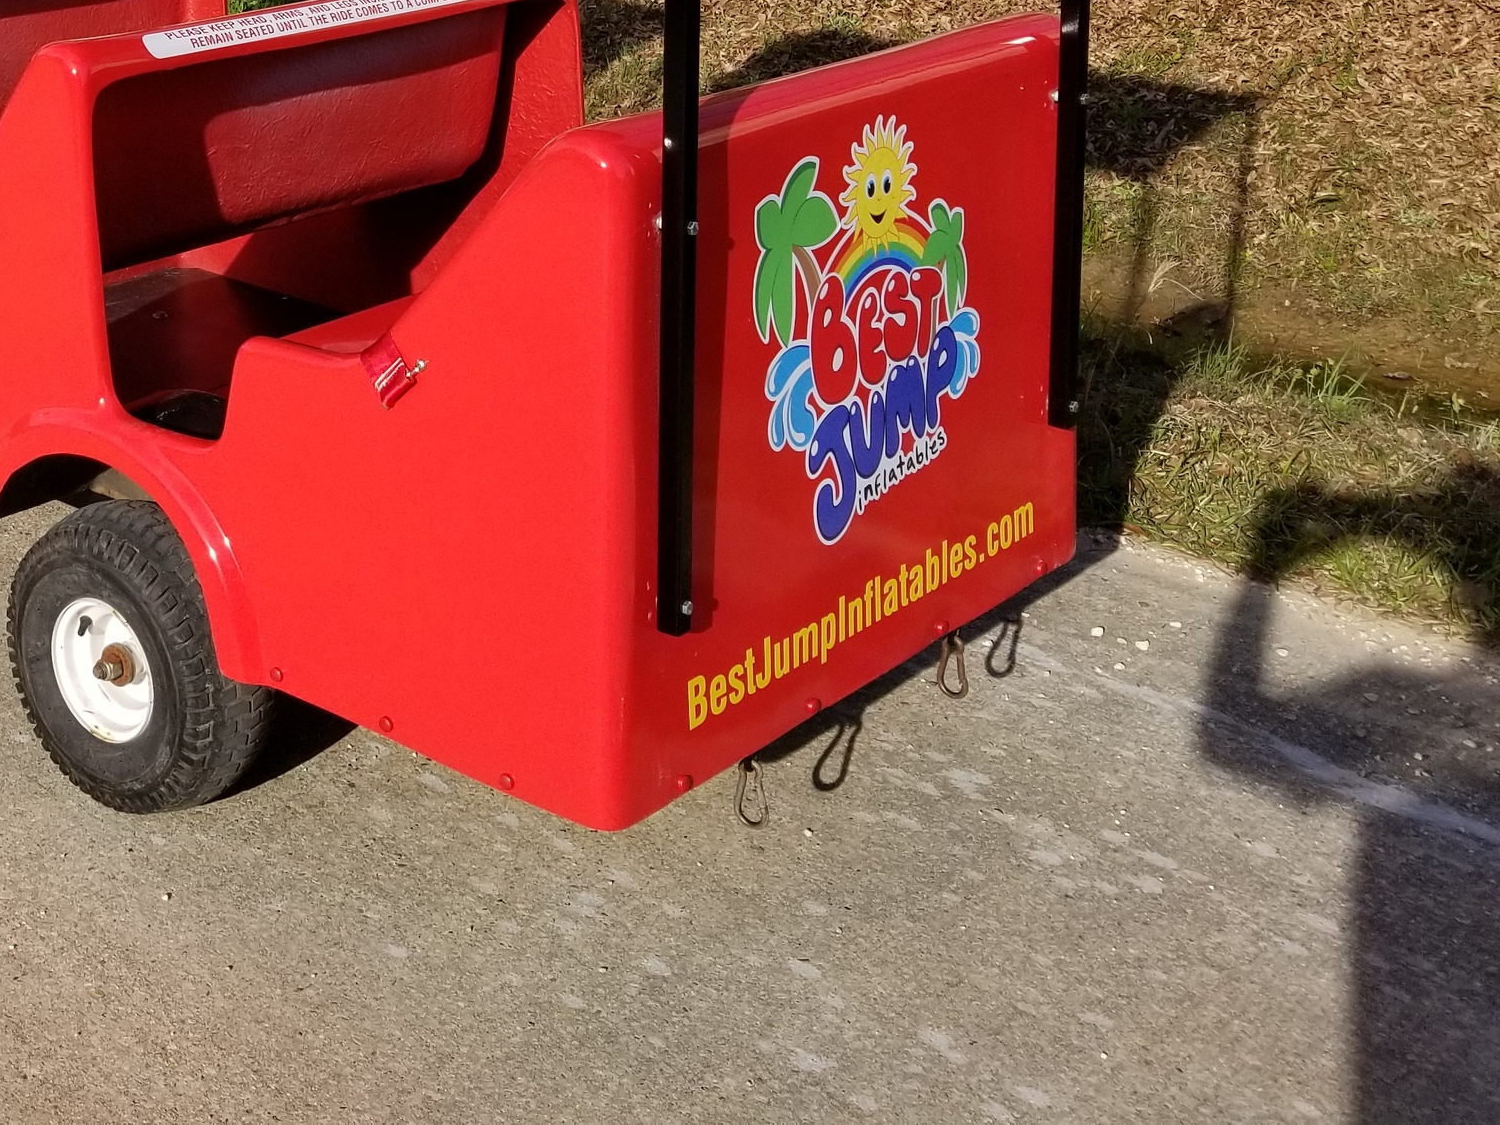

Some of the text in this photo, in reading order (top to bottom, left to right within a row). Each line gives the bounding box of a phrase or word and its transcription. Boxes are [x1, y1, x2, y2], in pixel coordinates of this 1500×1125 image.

[164, 26, 209, 41] PLEASE
[210, 21, 235, 32] KEEP
[308, 3, 330, 14] AND
[190, 31, 233, 48] REMAIN
[234, 24, 275, 40] SEATED
[276, 17, 308, 32] UNTIL
[309, 13, 329, 26] THE
[331, 9, 354, 21] RIDE
[356, 2, 389, 17] COMES
[391, 0, 404, 10] TO
[811, 267, 943, 405] BEST
[809, 325, 958, 542] JUMP
[858, 431, 946, 512] inflatables
[687, 501, 1035, 731] BestJumpInflatables.com
